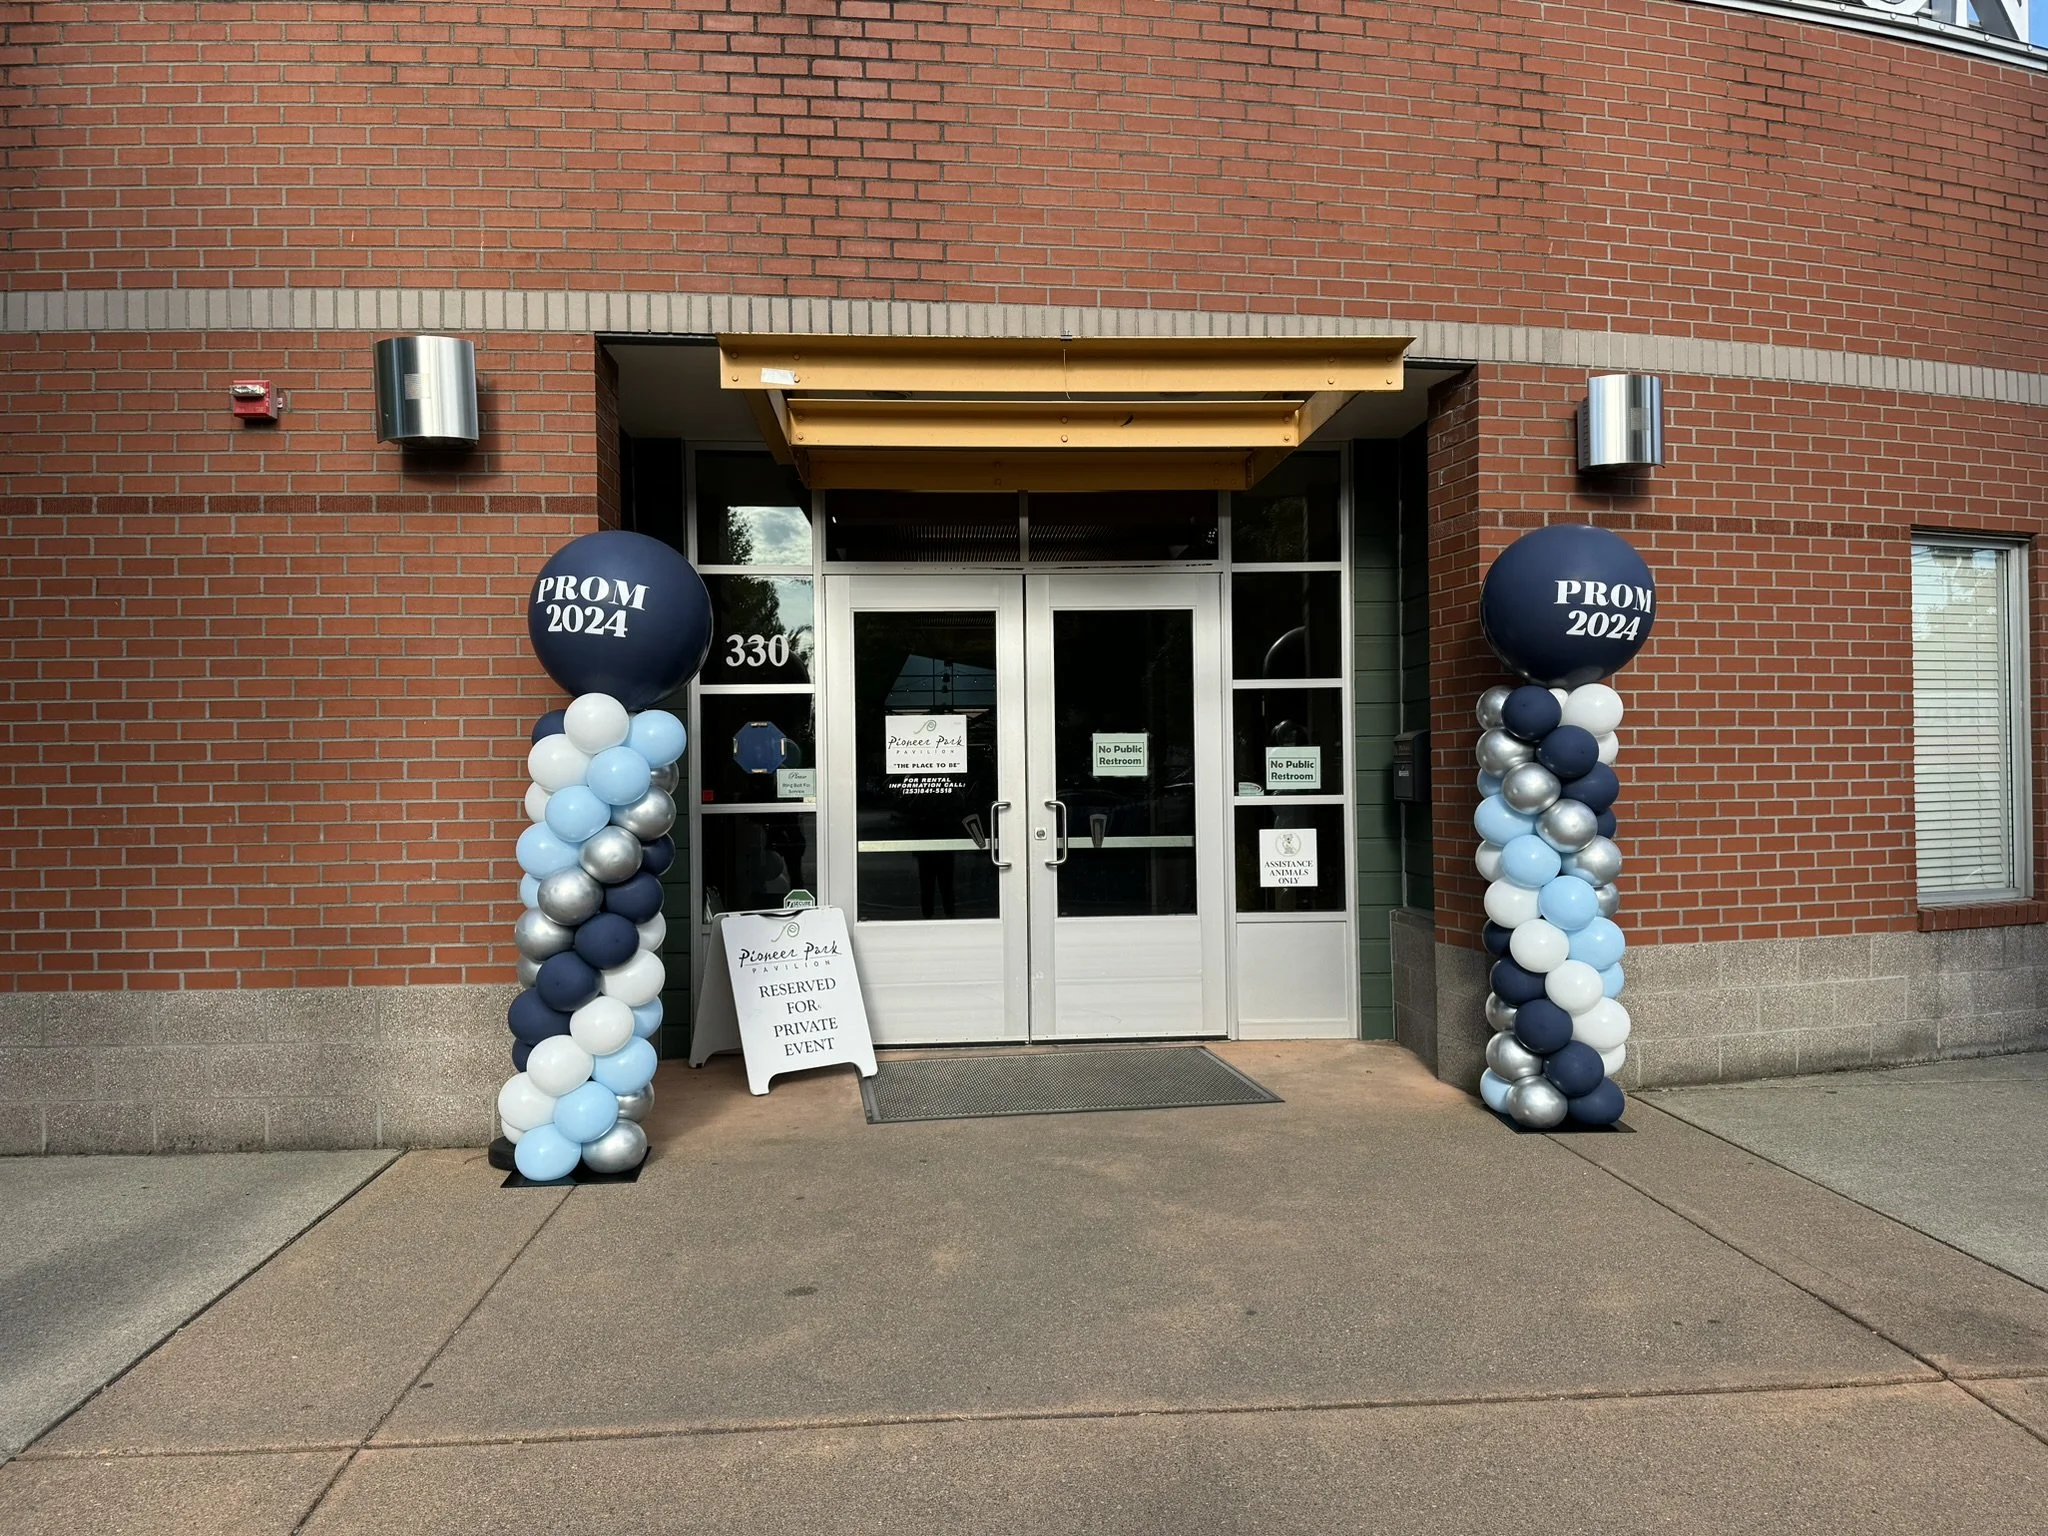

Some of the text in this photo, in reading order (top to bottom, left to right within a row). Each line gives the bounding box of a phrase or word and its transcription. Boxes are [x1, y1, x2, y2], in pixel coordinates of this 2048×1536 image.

[536, 575, 650, 611] PROM
[1554, 580, 1652, 613] PROM
[546, 604, 628, 638] 2024
[1566, 610, 1641, 641] 2024
[726, 634, 789, 667] 330
[888, 735, 965, 750] Pioneer Park
[1098, 744, 1143, 753] No Public
[1099, 757, 1142, 765] Restroom
[1270, 760, 1315, 769] No Public
[1271, 772, 1314, 780] Restroom
[1264, 860, 1314, 868] ASSISTANCE
[739, 940, 843, 968] Pioneer Park
[752, 959, 831, 974] PAVILION
[759, 977, 836, 998] RESERVED
[786, 999, 819, 1015] FOR
[773, 1017, 839, 1038] PRIVATE
[784, 1037, 835, 1056] EVENT
